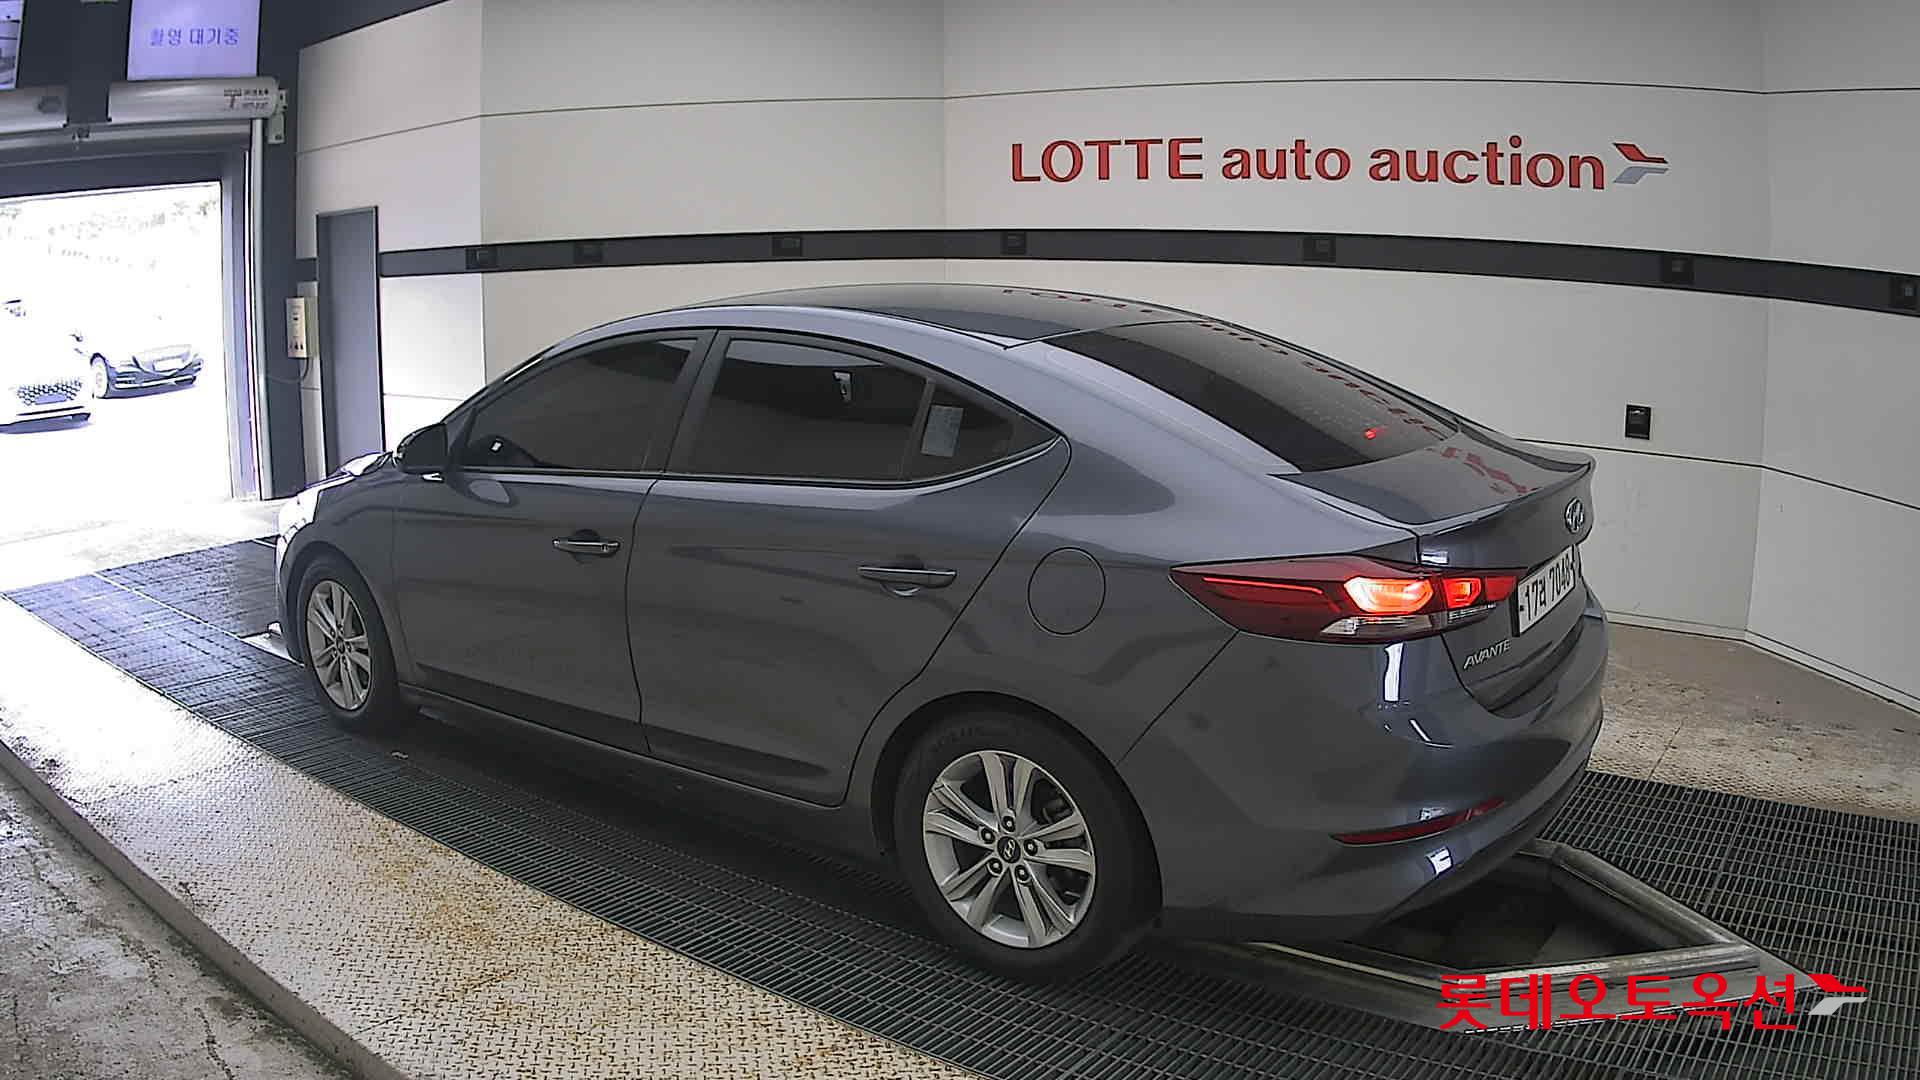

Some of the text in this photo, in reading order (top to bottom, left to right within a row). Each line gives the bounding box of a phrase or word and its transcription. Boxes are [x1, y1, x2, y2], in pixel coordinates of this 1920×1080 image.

[189, 28, 239, 46] 대기중
[1011, 136, 1605, 189] LOTTE auto auction
[1463, 639, 1511, 670] AVANTE
